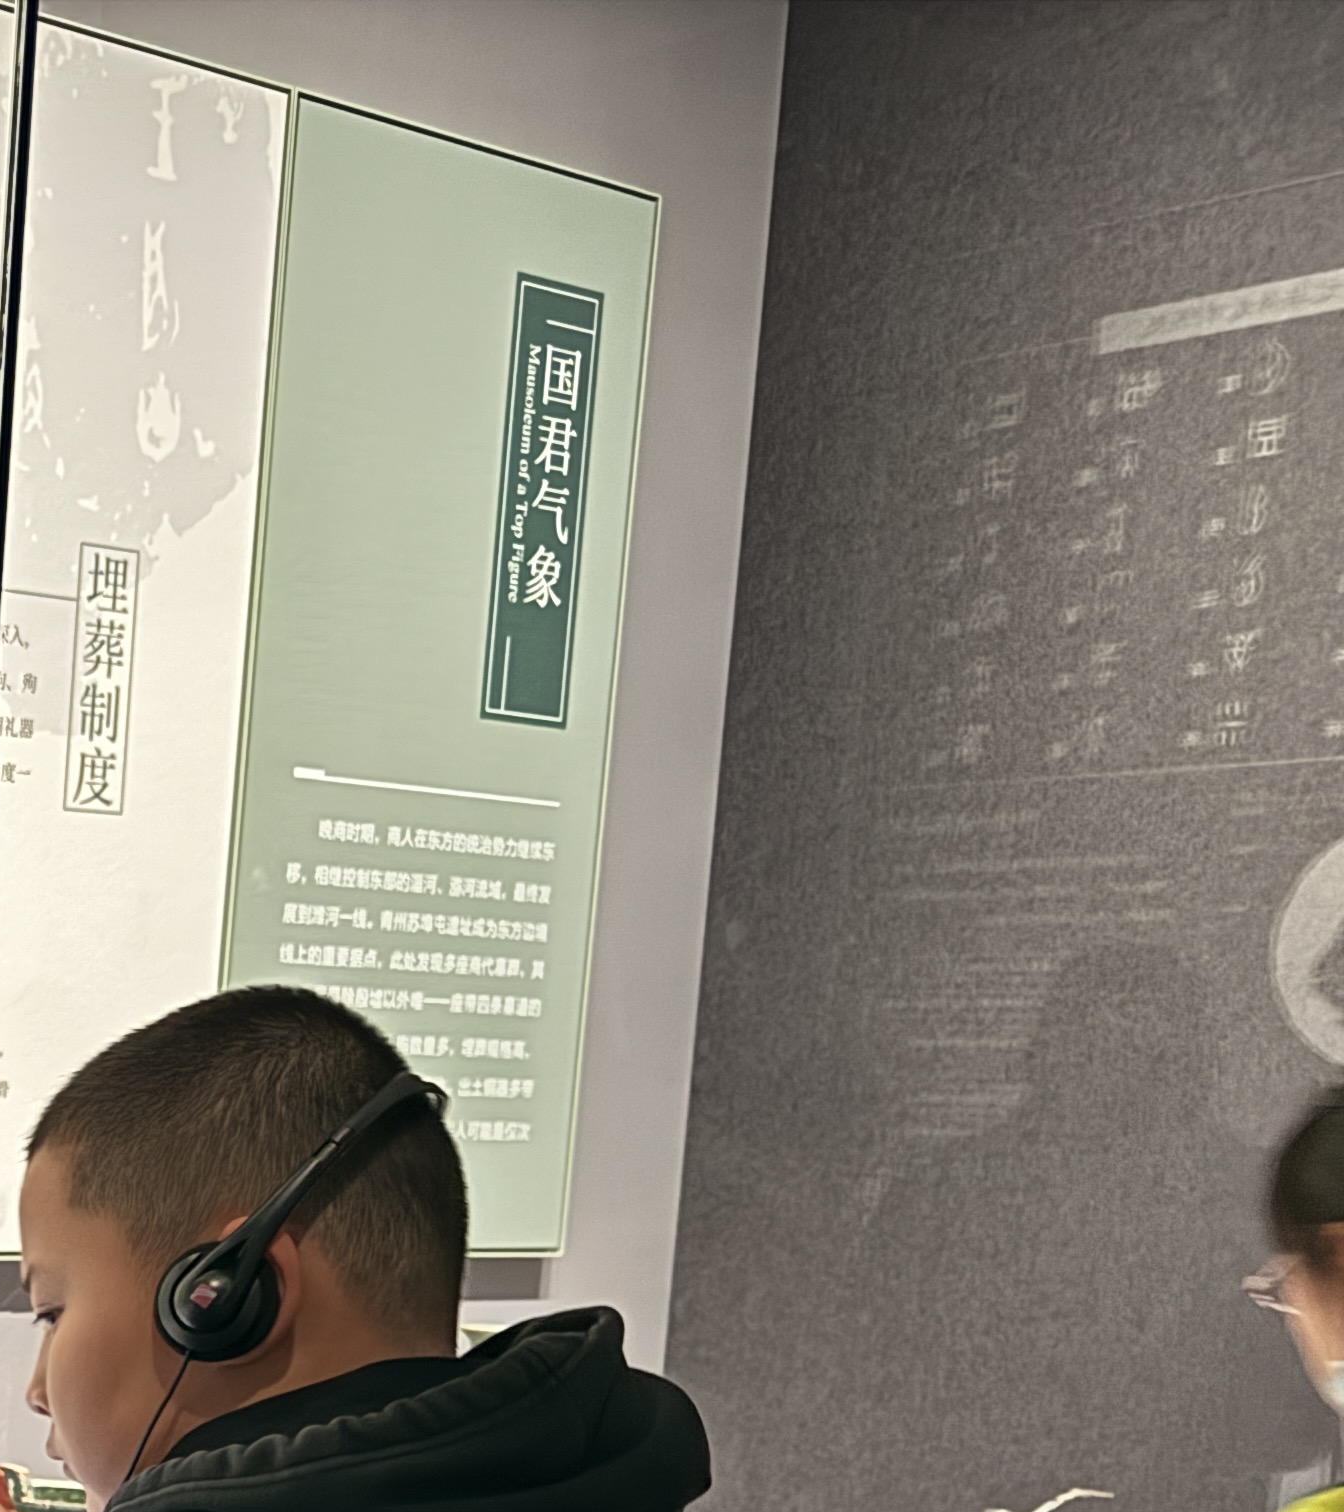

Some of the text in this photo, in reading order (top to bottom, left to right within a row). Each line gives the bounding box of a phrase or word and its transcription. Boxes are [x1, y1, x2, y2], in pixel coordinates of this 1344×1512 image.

[520, 343, 541, 455] Mausoleum
[518, 458, 531, 482] of
[523, 343, 582, 608] 国君气象
[511, 500, 529, 539] Top
[507, 543, 525, 604] Figure
[72, 552, 129, 807] 埋葬制度
